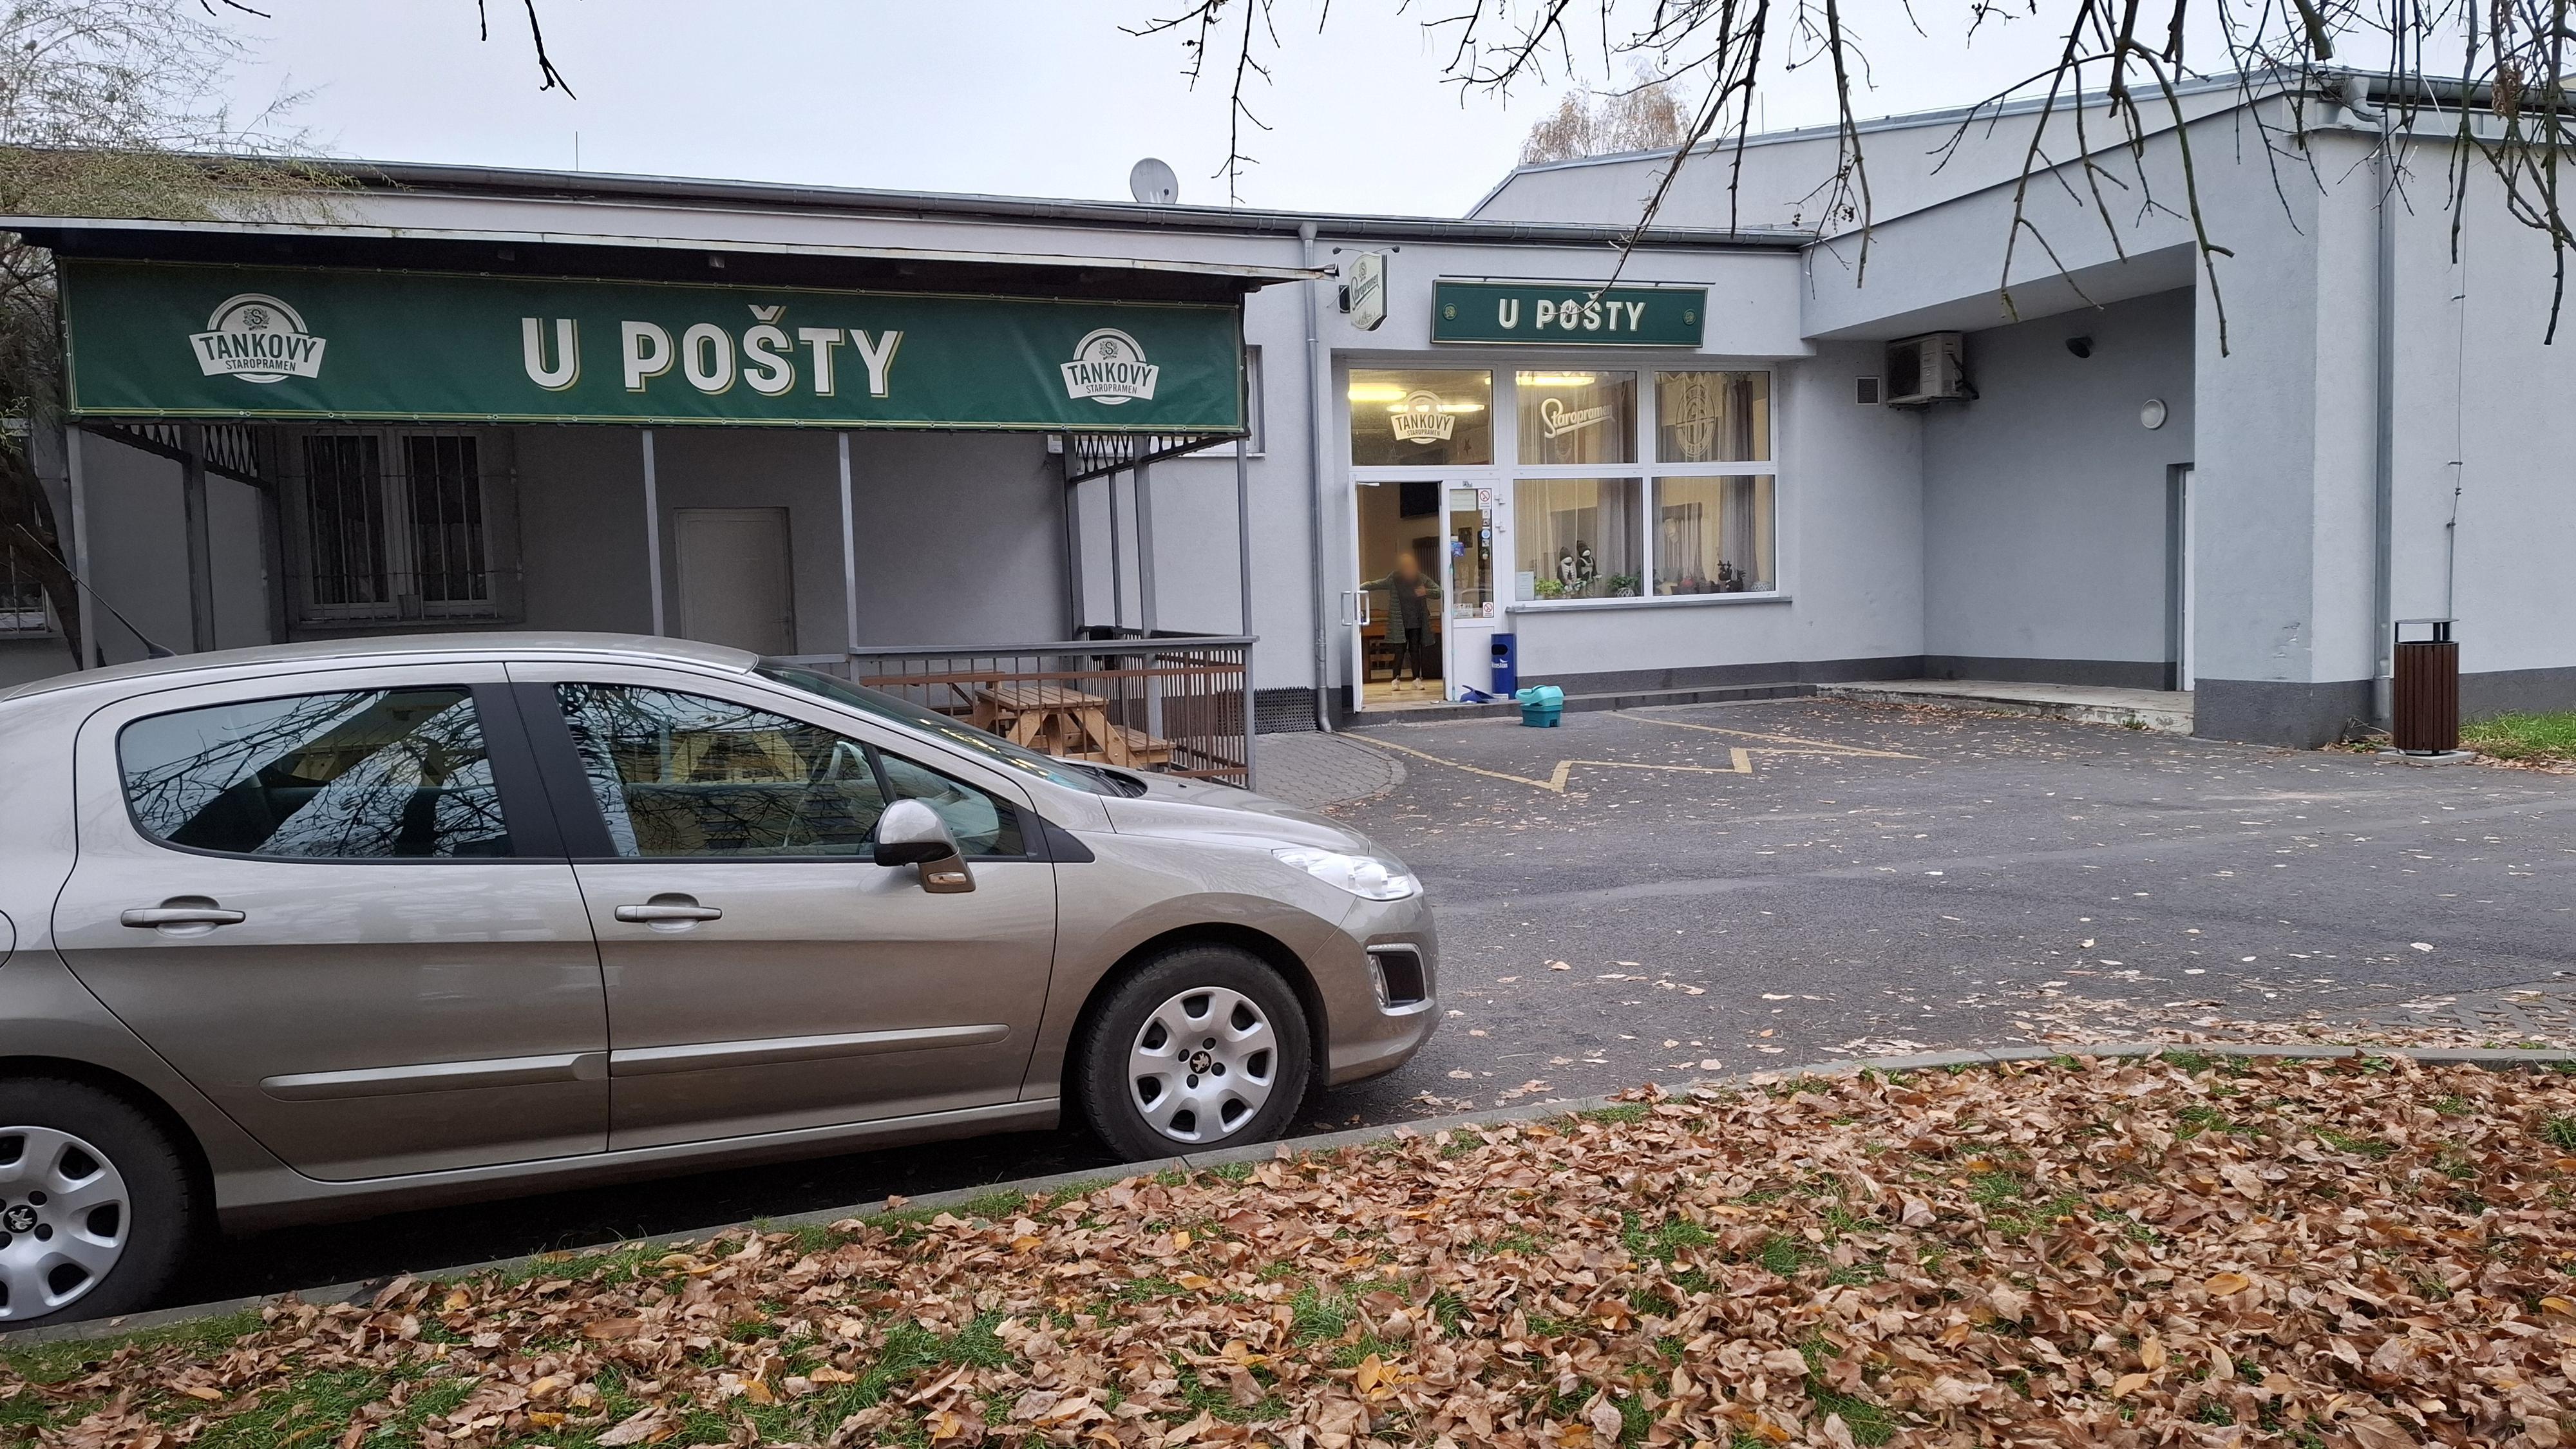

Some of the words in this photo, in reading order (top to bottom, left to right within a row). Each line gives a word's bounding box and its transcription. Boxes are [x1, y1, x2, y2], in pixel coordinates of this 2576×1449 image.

[1499, 298, 1519, 329] U
[1536, 292, 1646, 331] POŠTY
[522, 316, 581, 392] U
[621, 304, 904, 398] POŠTY
[225, 359, 296, 372] STAROPRAMEN
[1086, 383, 1137, 394] STAROPRAMEN
[1541, 398, 1615, 438] Staropramen
[1407, 429, 1440, 437] STAROPRAMEN
